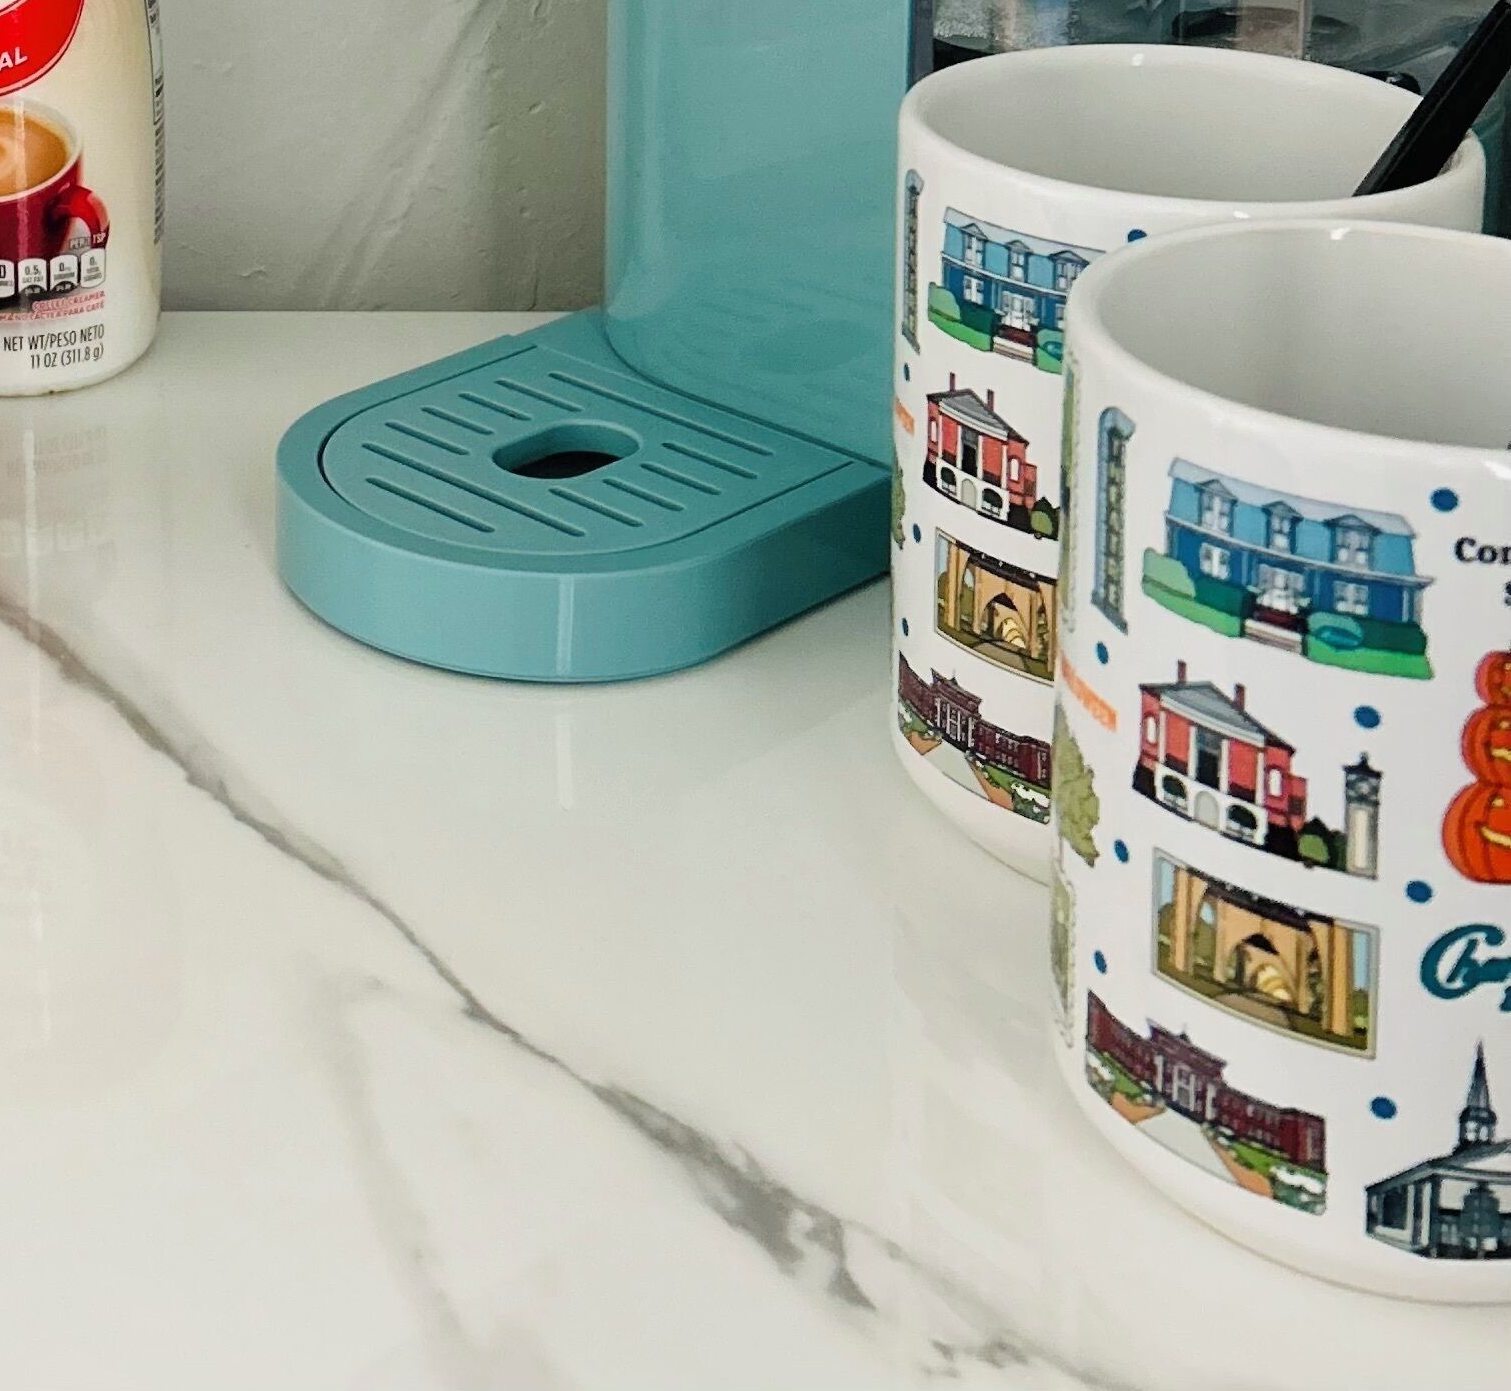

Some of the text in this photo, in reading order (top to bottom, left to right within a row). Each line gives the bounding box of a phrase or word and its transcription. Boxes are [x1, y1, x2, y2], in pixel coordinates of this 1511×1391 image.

[3, 323, 105, 352] NET WT/PESO NETO
[30, 354, 41, 370] 11
[43, 352, 58, 368] OZ
